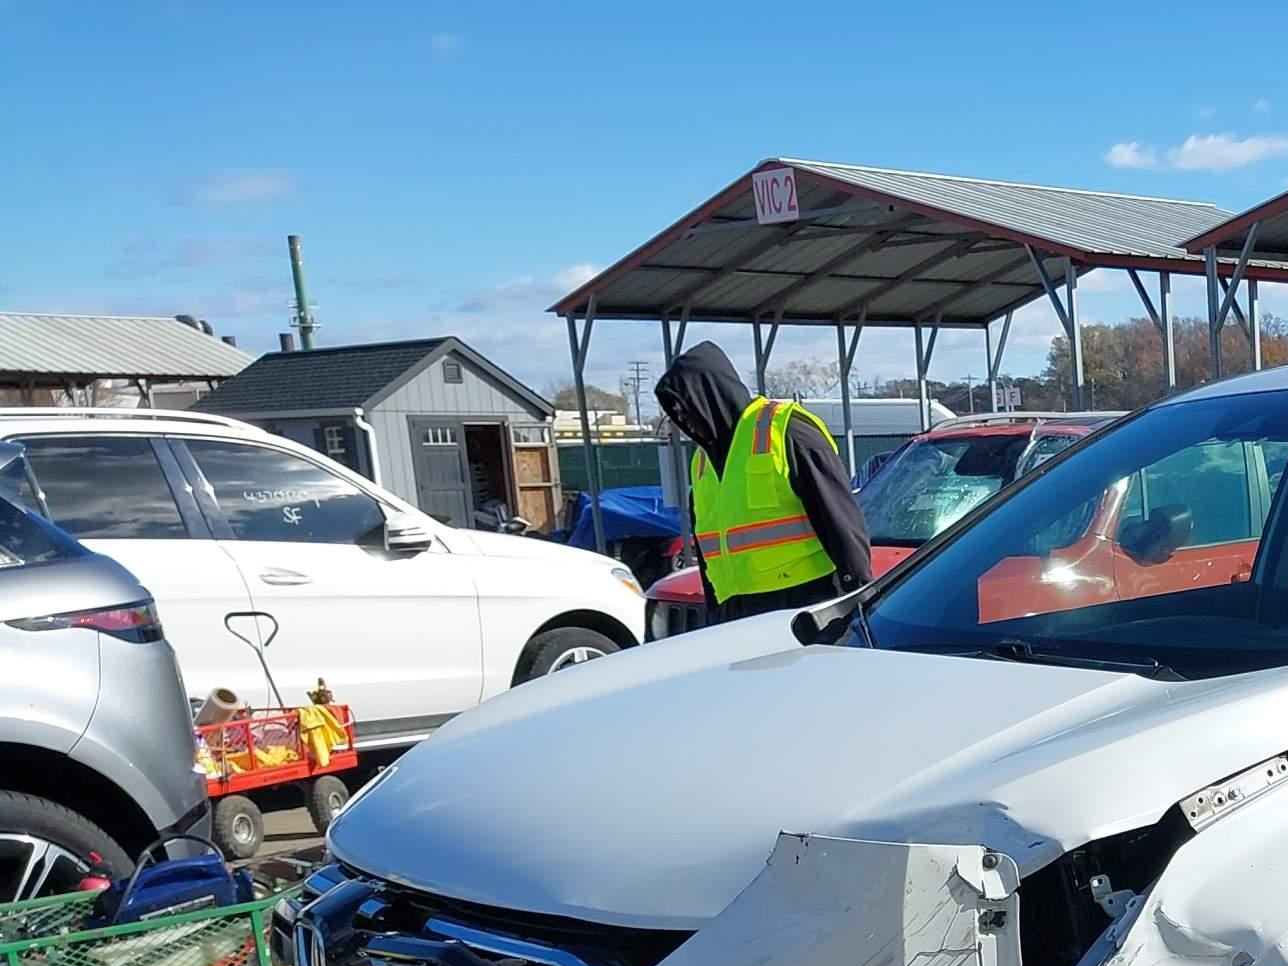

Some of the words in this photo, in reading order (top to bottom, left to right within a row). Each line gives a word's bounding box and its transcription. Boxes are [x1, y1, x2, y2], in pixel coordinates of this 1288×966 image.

[754, 178, 783, 216] VIC
[784, 175, 797, 212] 2
[282, 505, 303, 526] SF
